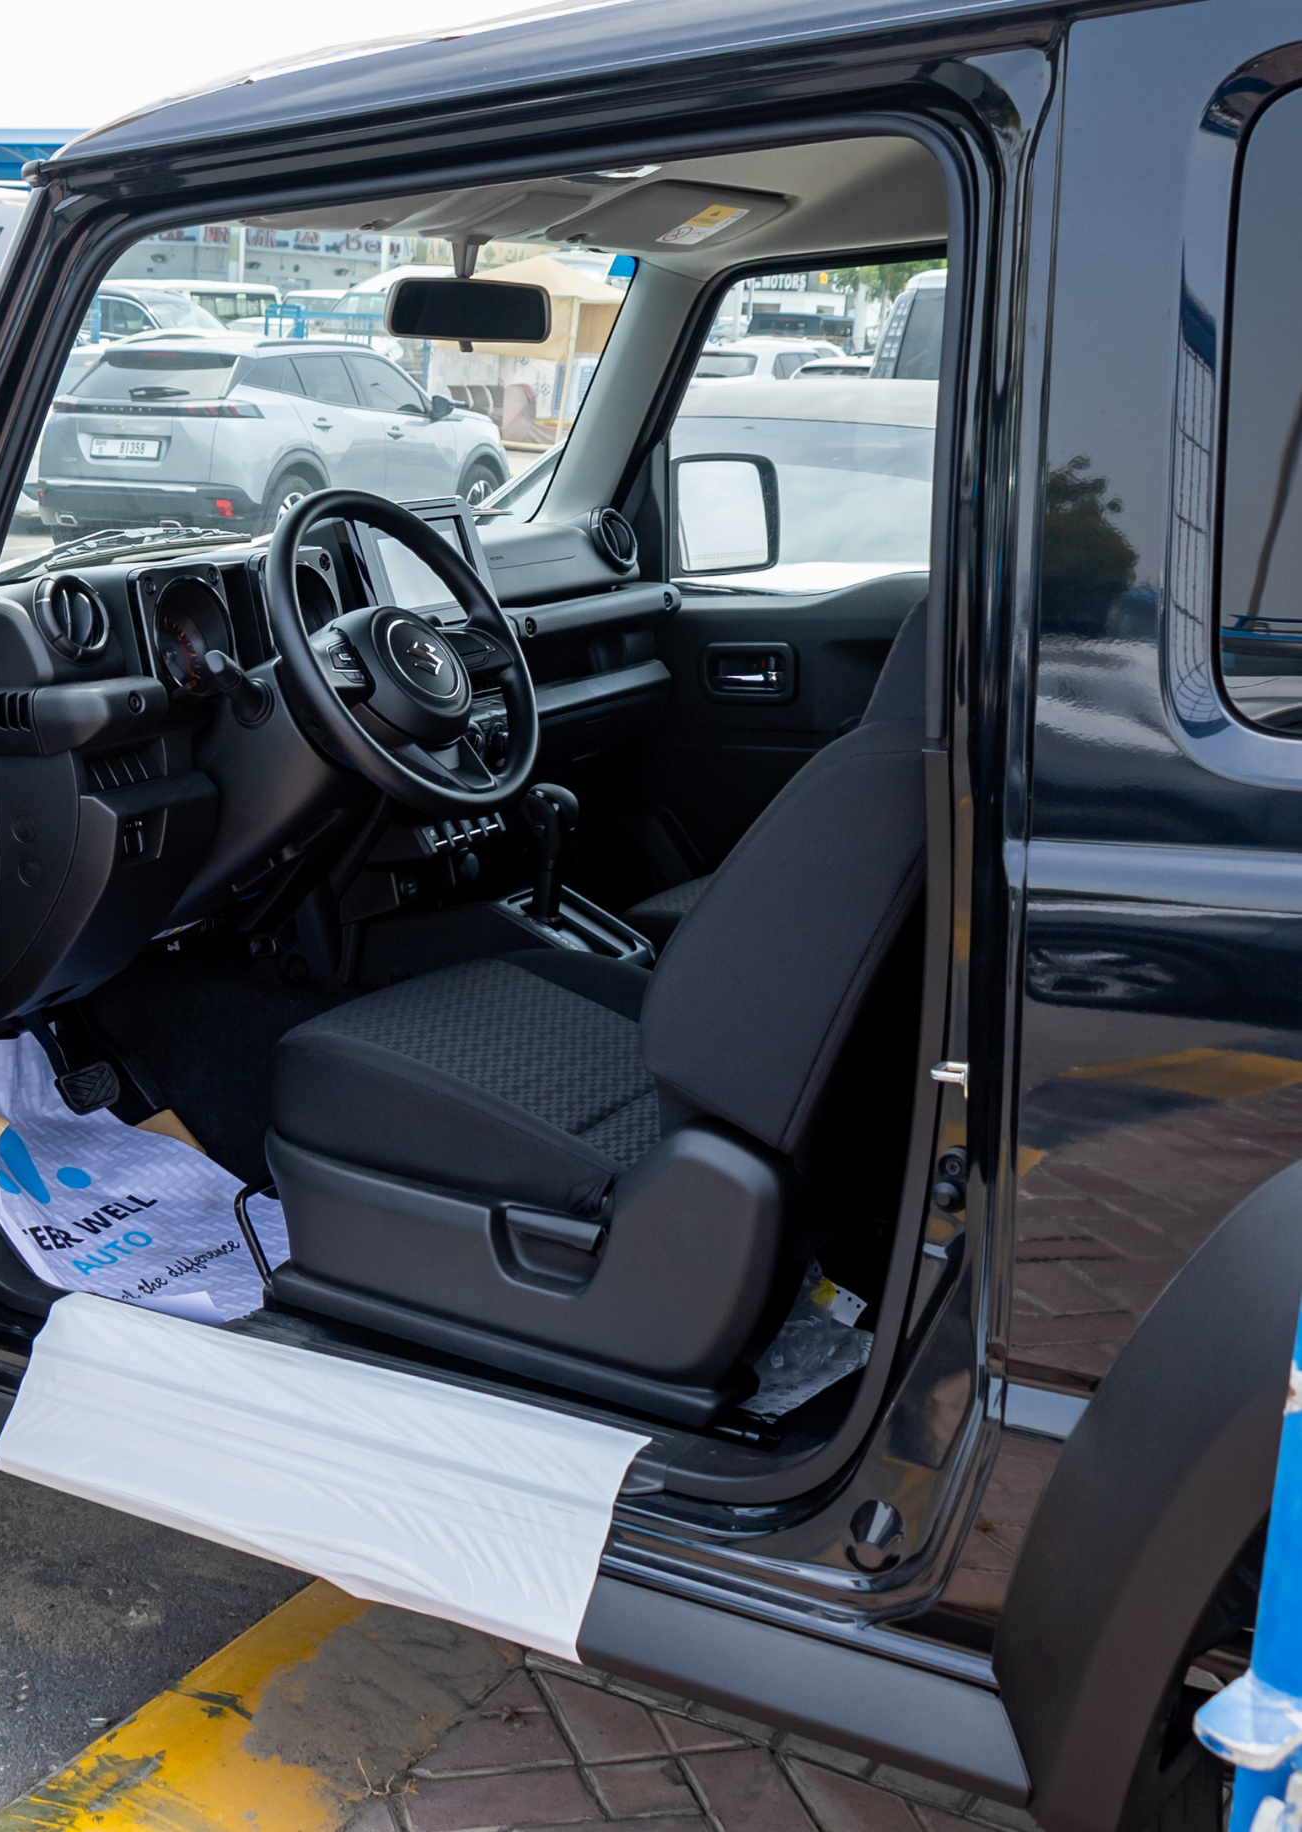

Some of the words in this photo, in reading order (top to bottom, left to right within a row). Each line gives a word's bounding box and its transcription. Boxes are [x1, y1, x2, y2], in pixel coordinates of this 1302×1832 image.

[119, 441, 146, 455] 81358
[71, 1194, 158, 1235] WELL
[72, 1231, 153, 1276] AUTO
[137, 1277, 168, 1295] the
[165, 1240, 240, 1277] difference
